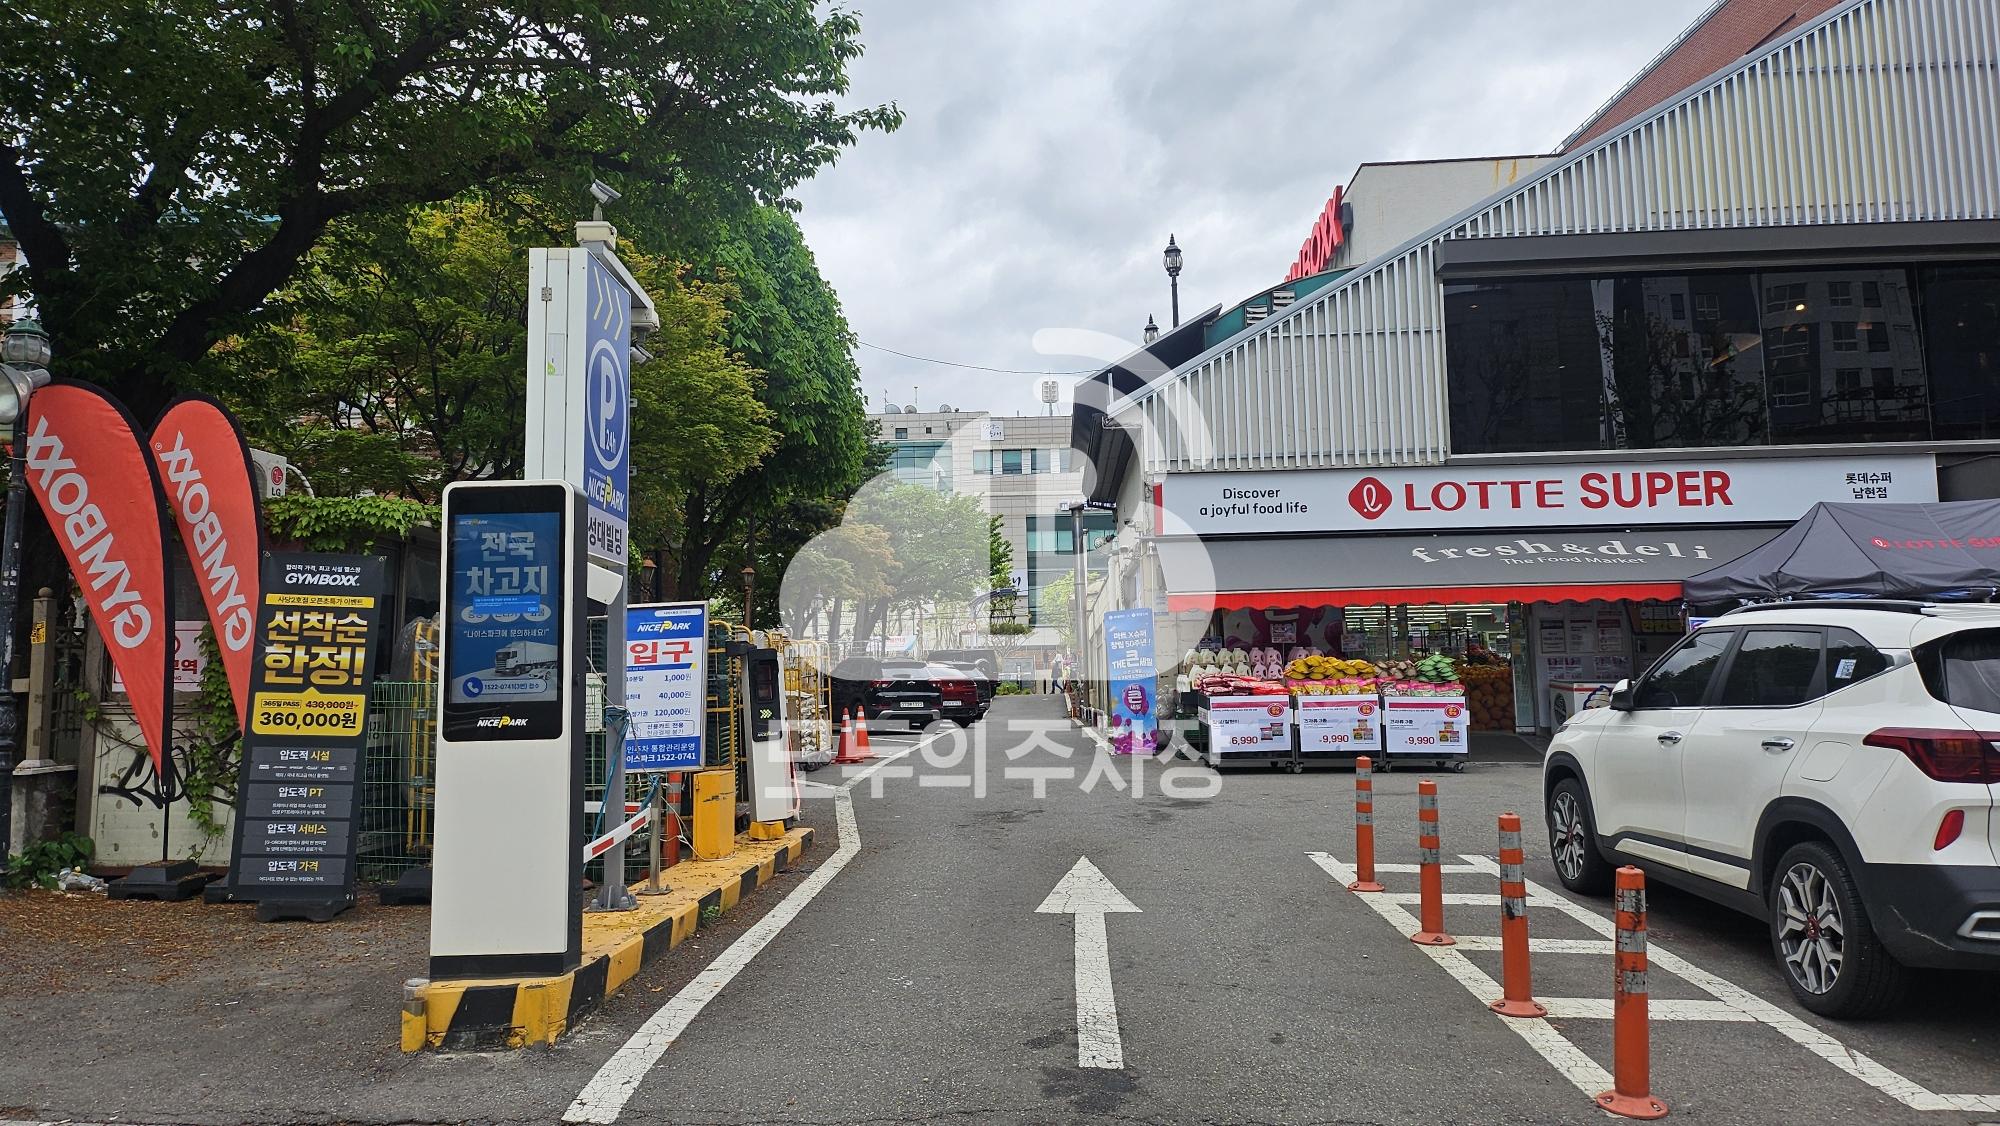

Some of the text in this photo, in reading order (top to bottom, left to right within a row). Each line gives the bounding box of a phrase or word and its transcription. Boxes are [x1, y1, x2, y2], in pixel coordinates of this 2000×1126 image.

[605, 429, 616, 454] 24h
[1845, 472, 1892, 485] 롯데슈퍼
[271, 487, 281, 496] LG
[587, 475, 625, 512] NICEPARK
[1222, 487, 1281, 499] Discover
[1404, 470, 1734, 512] LOTTE SUPER
[1852, 487, 1888, 499] 남현점
[1199, 501, 1308, 516] a joyful food life
[588, 517, 622, 556] 성대빌딩
[481, 532, 536, 562] 전국
[1537, 556, 1581, 564] Food
[1586, 556, 1648, 565] Market
[285, 572, 357, 586] GYMBOXX
[465, 565, 548, 595] 차고지
[344, 598, 363, 606] 이벤트
[267, 610, 368, 643] 선착순
[637, 621, 692, 633] NICEPARK
[629, 641, 693, 665] 입구
[264, 643, 366, 686] 한정!
[664, 673, 692, 682] 1,000원
[658, 690, 692, 700] 40,000원
[262, 700, 282, 708] 365일
[654, 707, 691, 717] 120,000원
[259, 712, 357, 730] 360,000원
[477, 716, 528, 728] NICEPARK
[1231, 736, 1259, 746] 6,990
[1322, 734, 1349, 744] 9,990
[1408, 736, 1435, 746] 9,990
[280, 750, 330, 761] 압도적 시설
[657, 752, 696, 762] 1522-0741
[278, 786, 324, 798] 압도적 PT
[267, 823, 327, 834] 압도적 서비스
[268, 861, 319, 872] 압도적 가격
